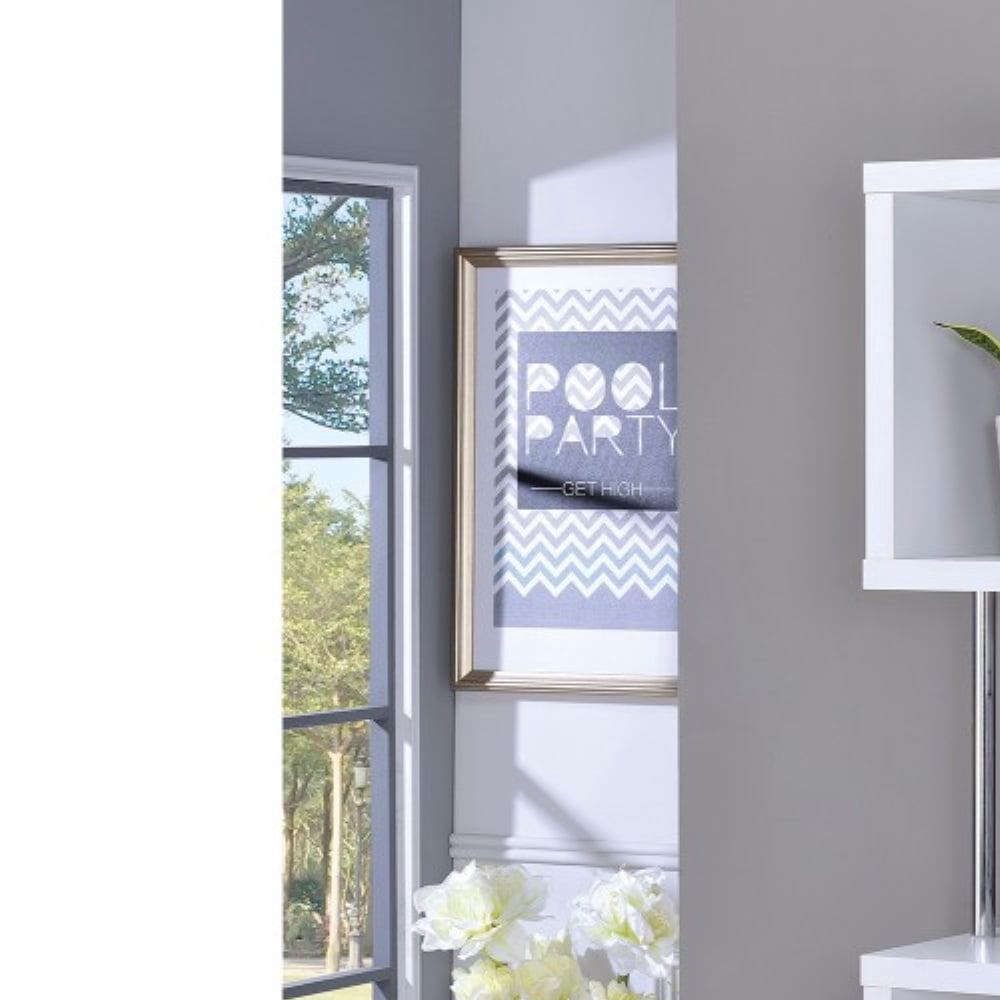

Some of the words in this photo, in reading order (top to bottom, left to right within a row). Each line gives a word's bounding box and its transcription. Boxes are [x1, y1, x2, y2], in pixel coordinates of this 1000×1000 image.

[525, 362, 678, 412] POOL
[524, 414, 678, 456] PARTY
[562, 480, 597, 497] GET
[601, 480, 643, 497] HIGH
